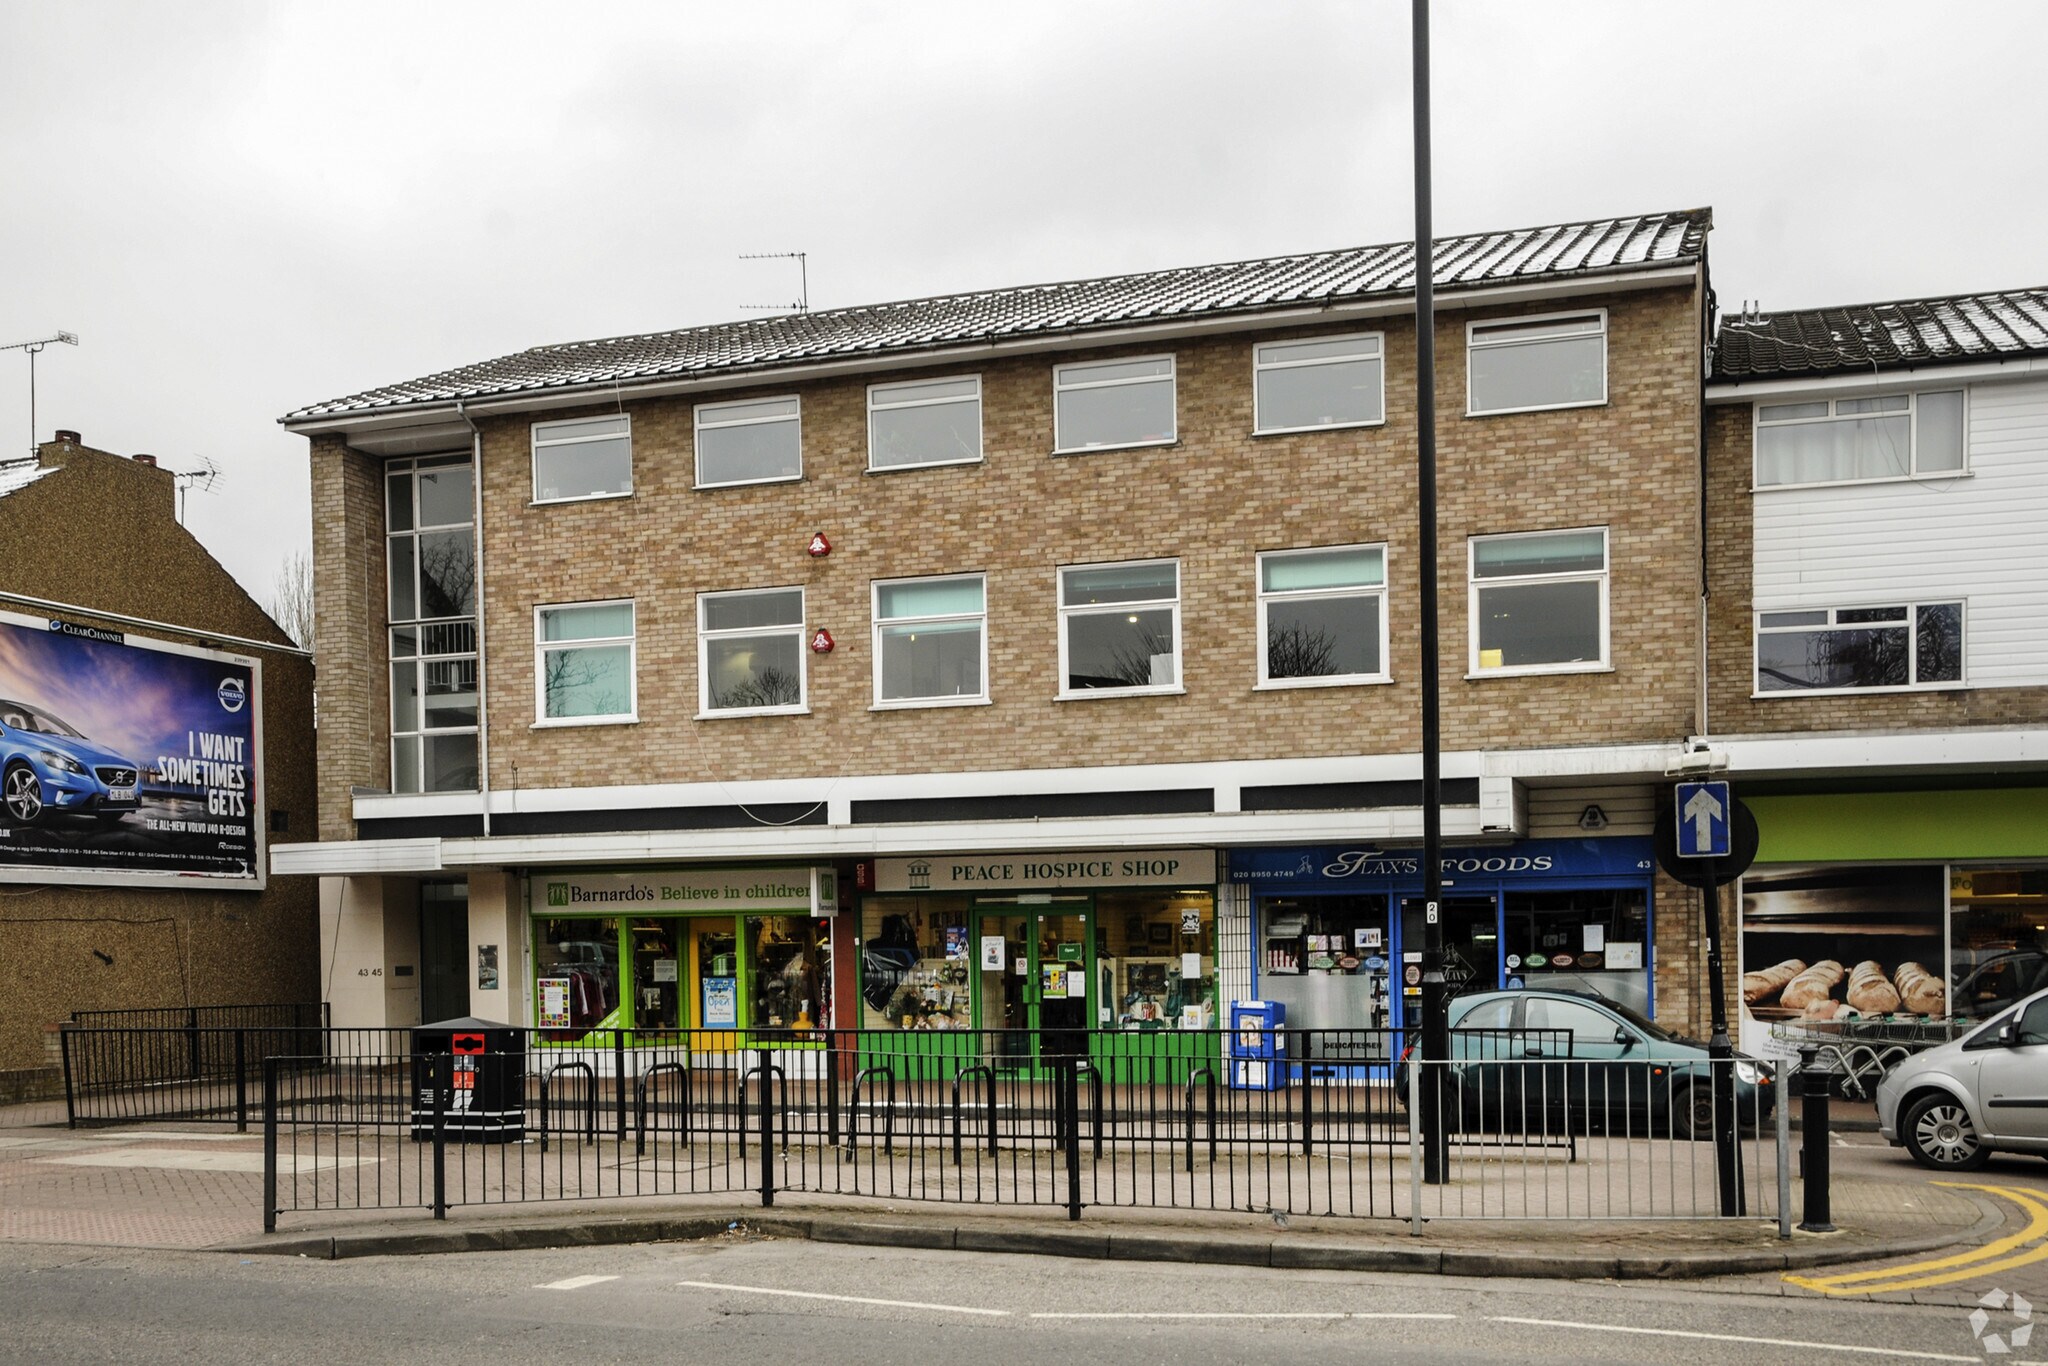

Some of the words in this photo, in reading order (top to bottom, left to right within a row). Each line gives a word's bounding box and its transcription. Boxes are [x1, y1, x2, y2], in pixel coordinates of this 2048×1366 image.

[220, 691, 243, 699] VOLVO
[189, 731, 194, 757] I
[199, 732, 244, 762] WANT
[157, 756, 245, 789] SOMETIMES
[208, 789, 246, 817] GETS
[146, 819, 159, 830] THE
[159, 820, 187, 832] ALL-NEW
[187, 821, 206, 834] VOLVO
[207, 824, 219, 834] V40
[219, 825, 246, 836] R-DESIGN
[952, 864, 1014, 881] PEACE
[1023, 861, 1113, 880] HOSPICE
[1122, 860, 1180, 877] SHOP
[1440, 856, 1552, 873] FOODS
[1637, 860, 1650, 869] 43
[1251, 870, 1271, 878] 8950
[570, 884, 654, 902] Barnardo's
[661, 886, 719, 900] Believe
[724, 885, 741, 899] in
[358, 969, 369, 977] 43
[371, 968, 383, 976] 45
